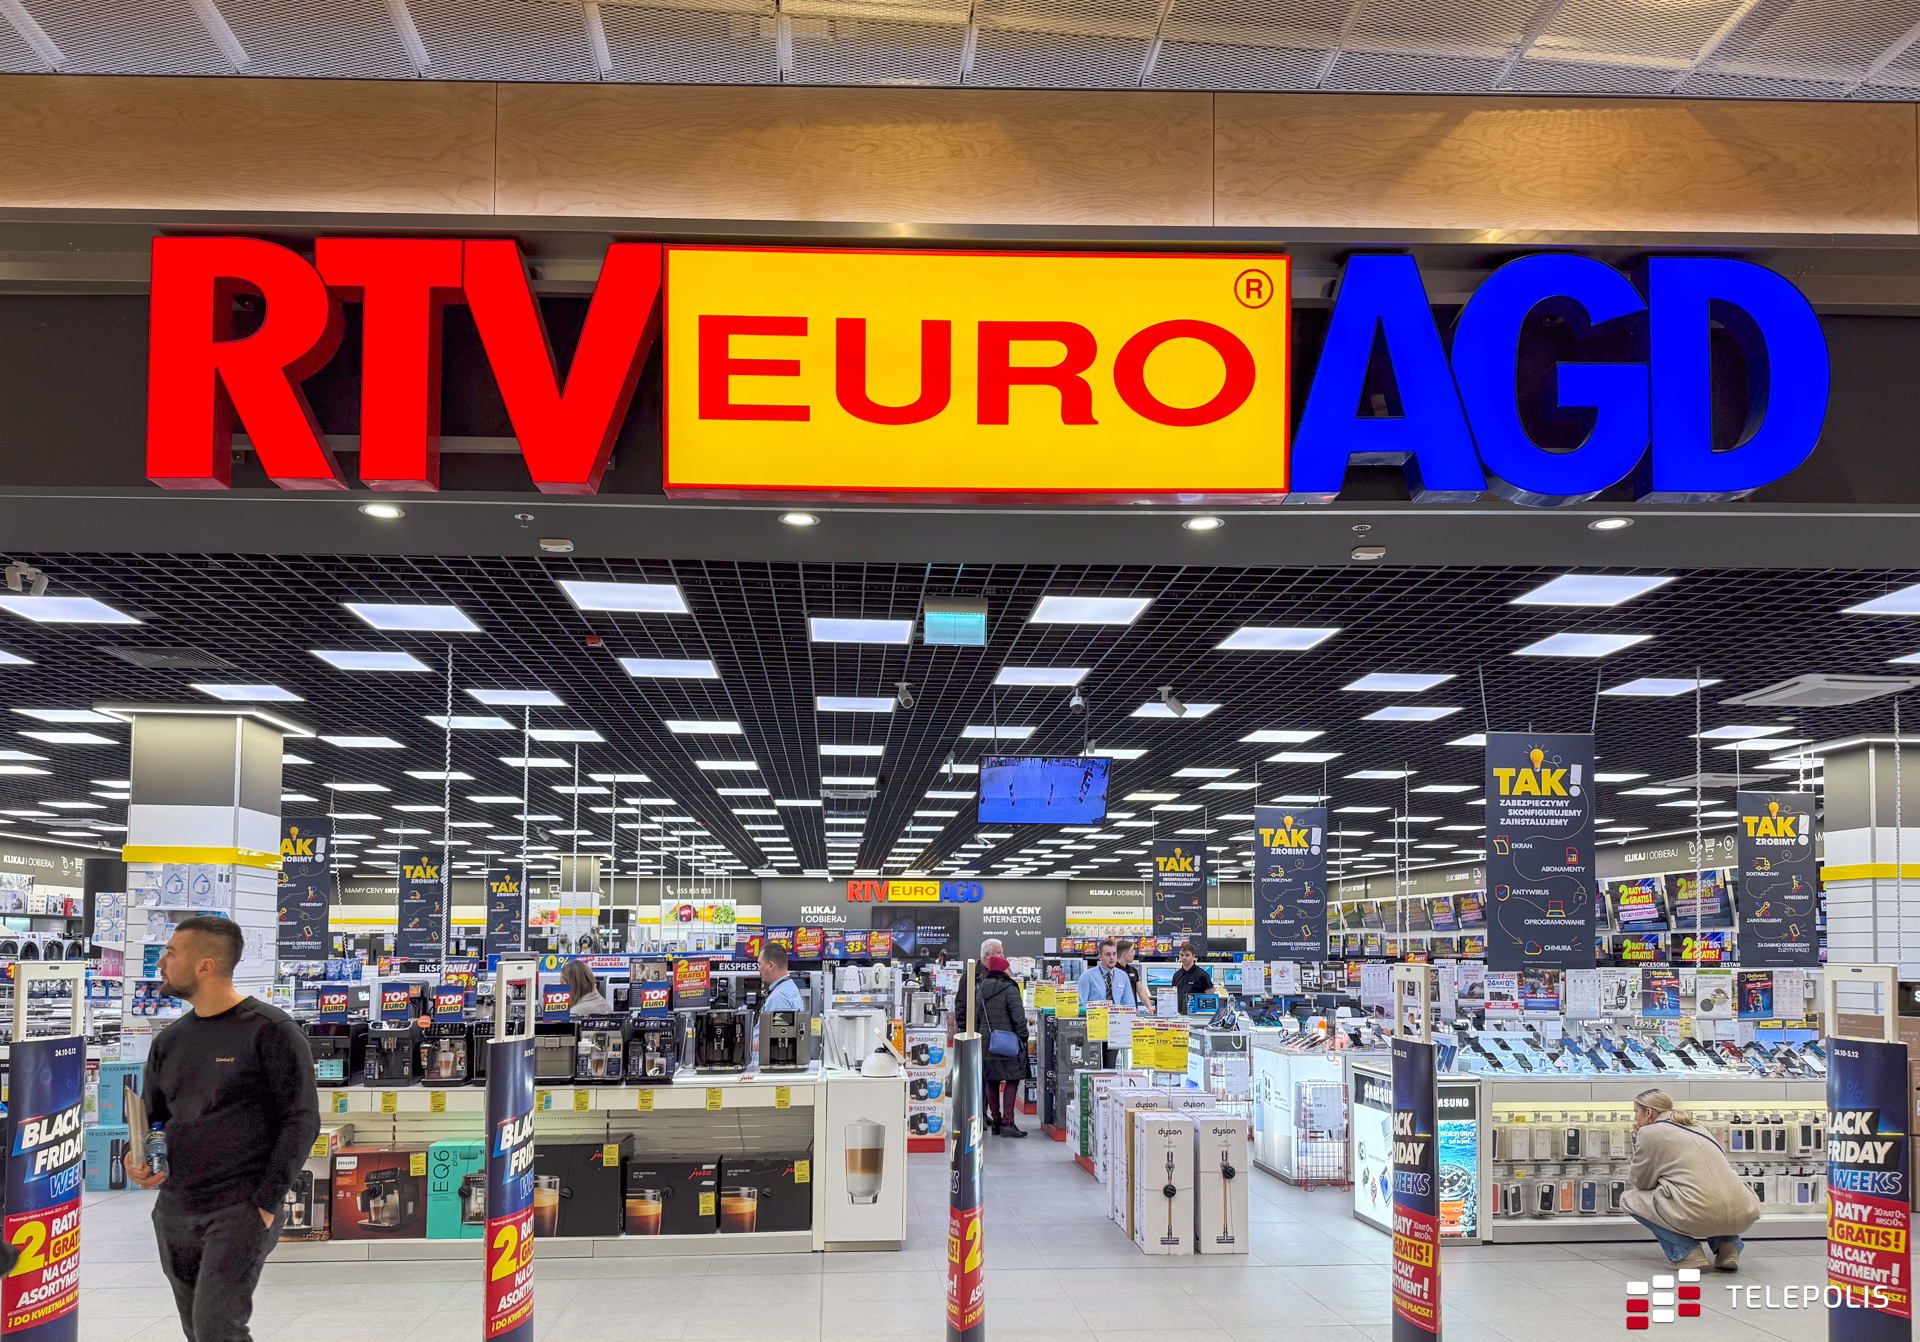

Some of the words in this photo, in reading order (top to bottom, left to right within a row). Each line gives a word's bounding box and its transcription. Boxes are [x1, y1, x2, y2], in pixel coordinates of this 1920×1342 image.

[146, 237, 662, 491] RTV
[699, 315, 1256, 427] EURO
[1290, 254, 1830, 500] AGD
[1493, 764, 1582, 797] TAK!
[1500, 799, 1570, 807] ZABEZPIECZYMY
[1508, 808, 1582, 817] SKONFIGURUJEMY
[1500, 818, 1568, 826] ZAINSTALUJEMY
[1743, 815, 1810, 845] TAK!
[1259, 828, 1322, 856] TAK!
[1755, 838, 1797, 846] ZROBIMY
[280, 837, 327, 863] AK!
[1625, 852, 1645, 862] KLIKAJ
[1649, 848, 1678, 860] ODBIERAJ
[4, 854, 24, 865] KLIKAJ
[28, 857, 54, 868] ODBIERAJ
[1156, 855, 1201, 872] TAK!
[847, 881, 889, 901] RTV
[891, 886, 937, 896] EURO
[939, 881, 984, 902] AGD
[1619, 884, 1629, 905] 2
[1628, 886, 1642, 895] RATY
[1677, 878, 1689, 899] 2
[1629, 894, 1653, 905] GRATIS!
[801, 906, 836, 914] KLIKAJ
[983, 906, 1014, 915] MAMY
[1016, 906, 1041, 915] CENY
[805, 915, 847, 923] ODBIERAJ
[983, 915, 1041, 923] INTERNETOWE
[797, 927, 807, 937] 2
[870, 931, 879, 940] 2
[750, 938, 759, 957] 1
[1622, 939, 1632, 959] 2
[1631, 942, 1645, 950] RATY
[1682, 937, 1693, 959] 2
[1632, 950, 1654, 959] GRATIS!
[677, 960, 688, 973] 2
[689, 964, 707, 972] RATY
[677, 972, 706, 980] GRATIS!
[323, 994, 348, 1004] TOP
[384, 992, 408, 1001] TOP
[438, 995, 462, 1004] TOP
[546, 992, 570, 1003] TOP
[644, 989, 668, 1000] TOP
[1135, 1101, 1158, 1109] dyson
[1183, 1100, 1206, 1109] dyson
[21, 1104, 81, 1149] BLACK
[1827, 1111, 1873, 1135] LACK
[1158, 1128, 1182, 1137] dyson
[1212, 1127, 1236, 1137] dyson
[34, 1136, 82, 1175] FRIDA
[433, 1150, 449, 1192] EQ6
[688, 1168, 712, 1180] jura
[1833, 1168, 1903, 1195] WEEKS
[1835, 1200, 1873, 1223] RATY
[1873, 1207, 1883, 1216] 30
[1883, 1210, 1895, 1218] RAT
[1895, 1208, 1907, 1219] 0%
[51, 1208, 79, 1238] RATY
[1393, 1214, 1413, 1236] RATY
[1875, 1218, 1893, 1226] RRSO
[1893, 1218, 1904, 1227] 0%
[1836, 1222, 1900, 1249] GRATIS!
[1394, 1234, 1430, 1263] GRATIS!
[1830, 1243, 1844, 1258] NA
[1844, 1247, 1877, 1265] CAŁY
[42, 1265, 58, 1283] NA
[1397, 1260, 1415, 1279] CAŁY
[515, 1270, 525, 1287] NA
[14, 1314, 30, 1327] DO
[31, 1299, 65, 1320] KWIETNIA
[1409, 1303, 1433, 1318] PŁACISZ!
[496, 1318, 507, 1331] DO
